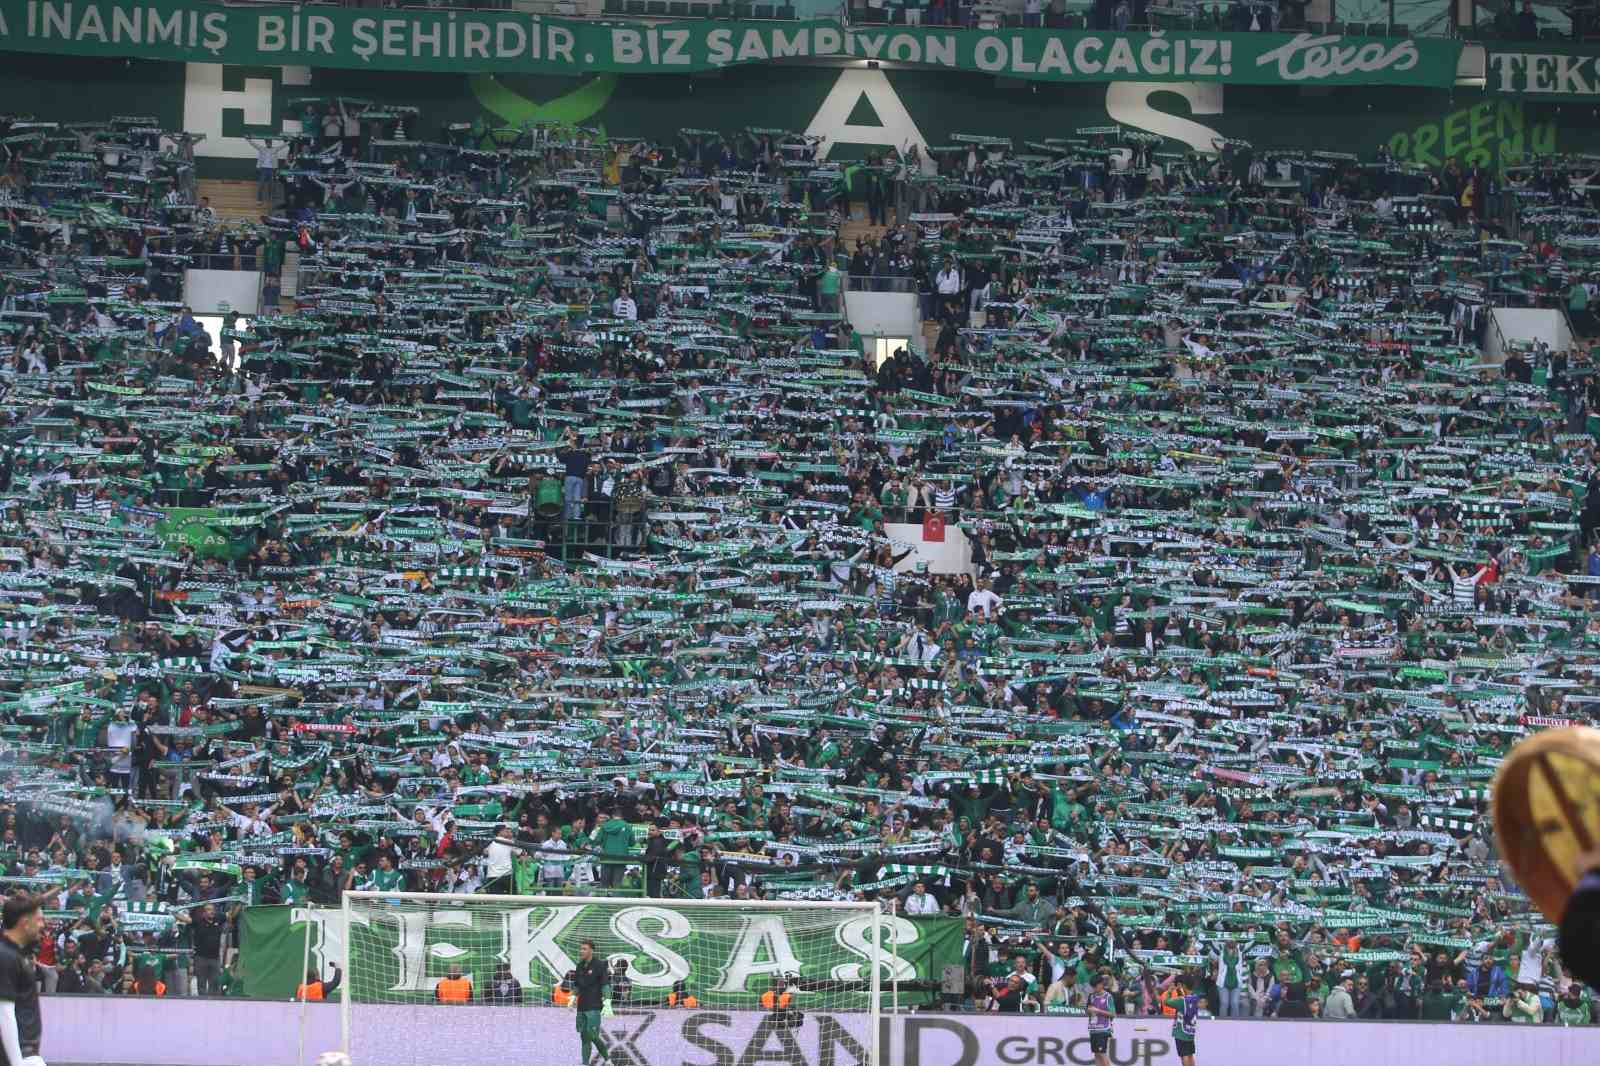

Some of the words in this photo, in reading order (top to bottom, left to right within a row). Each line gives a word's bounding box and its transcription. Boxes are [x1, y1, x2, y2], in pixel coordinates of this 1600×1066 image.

[257, 5, 336, 53] BİR
[351, 11, 594, 62] ŞEHİRDİR.
[611, 25, 692, 66] BİZ
[974, 31, 1234, 77] OLACAĞIZ!
[165, 532, 227, 545] TEXAS
[291, 903, 919, 990] TEKSAS
[996, 1035, 1170, 1066] GROUP
